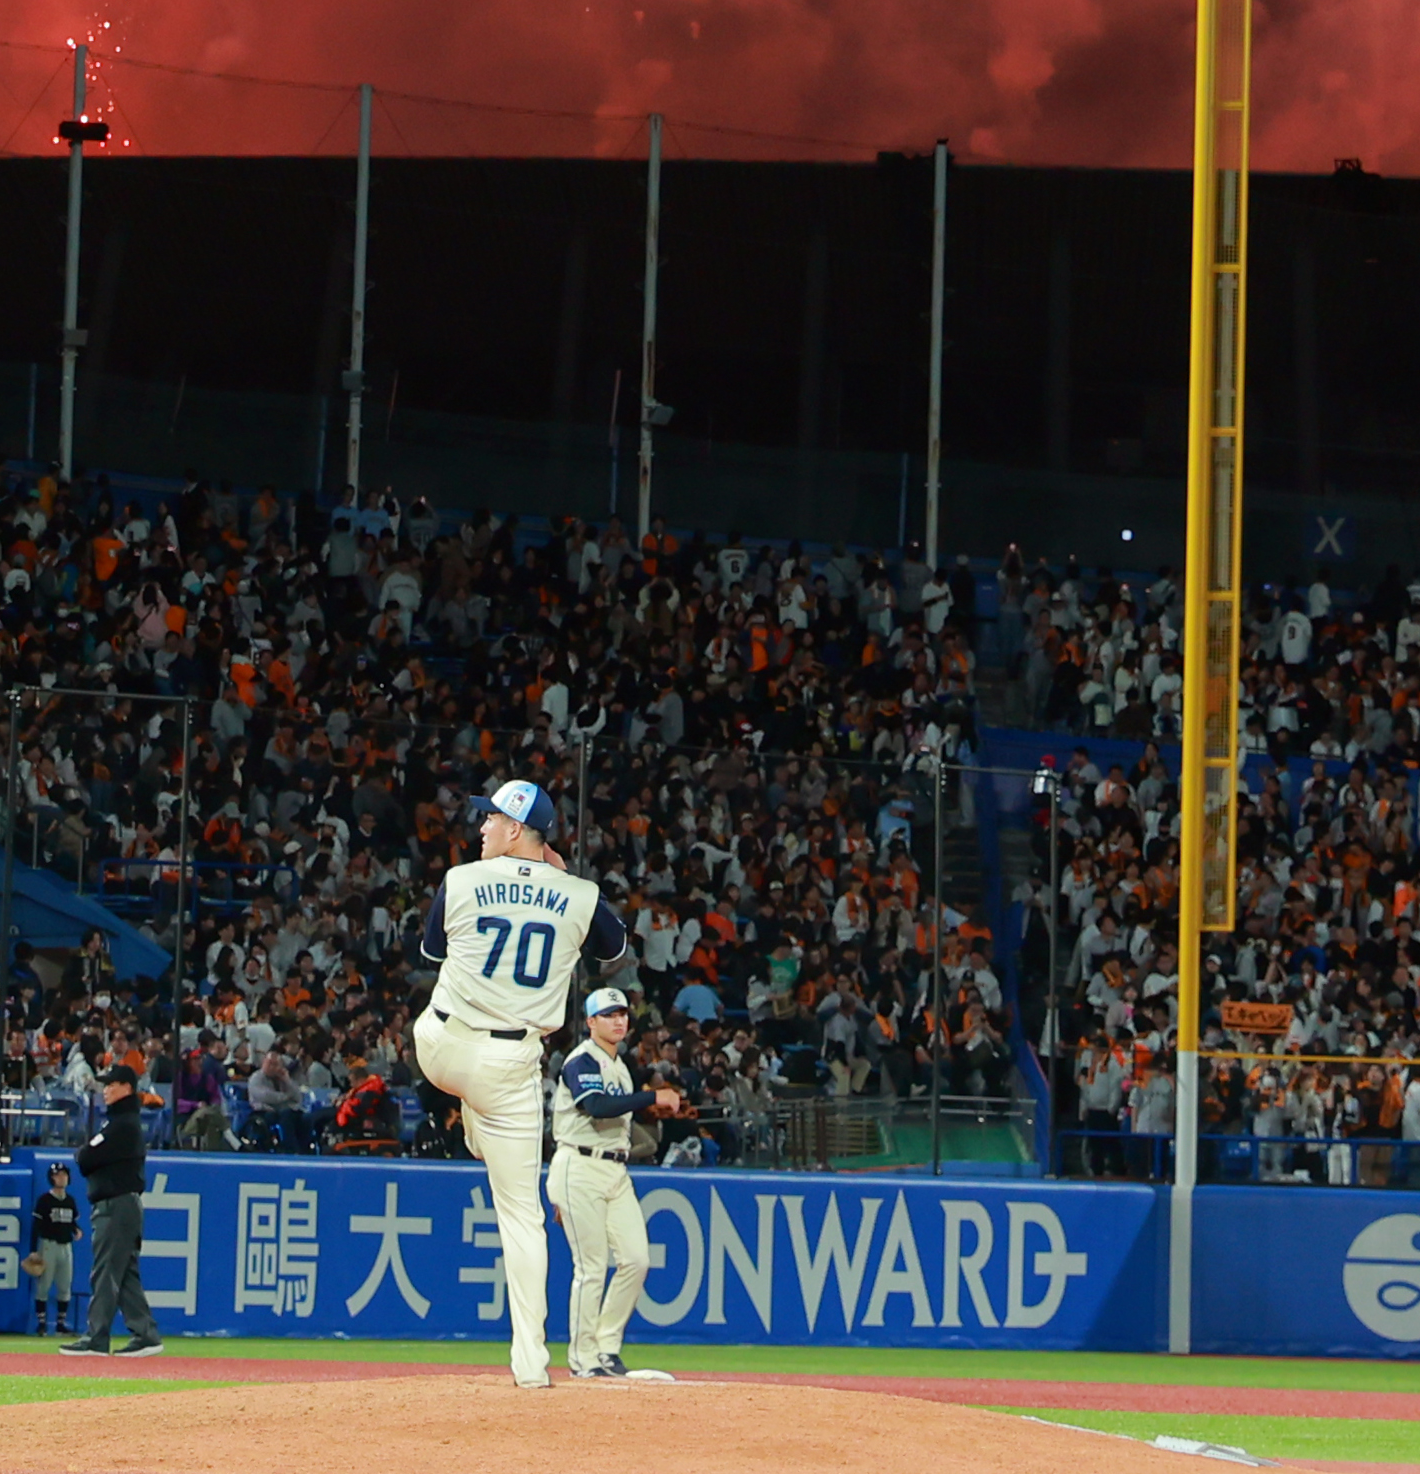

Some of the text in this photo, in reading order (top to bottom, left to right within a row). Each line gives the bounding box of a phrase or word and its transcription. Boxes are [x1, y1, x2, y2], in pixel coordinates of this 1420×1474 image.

[1314, 516, 1344, 555] X
[475, 883, 570, 917] HIROSAWA
[477, 916, 556, 988] 70
[608, 1184, 1087, 1333] ONWARD
